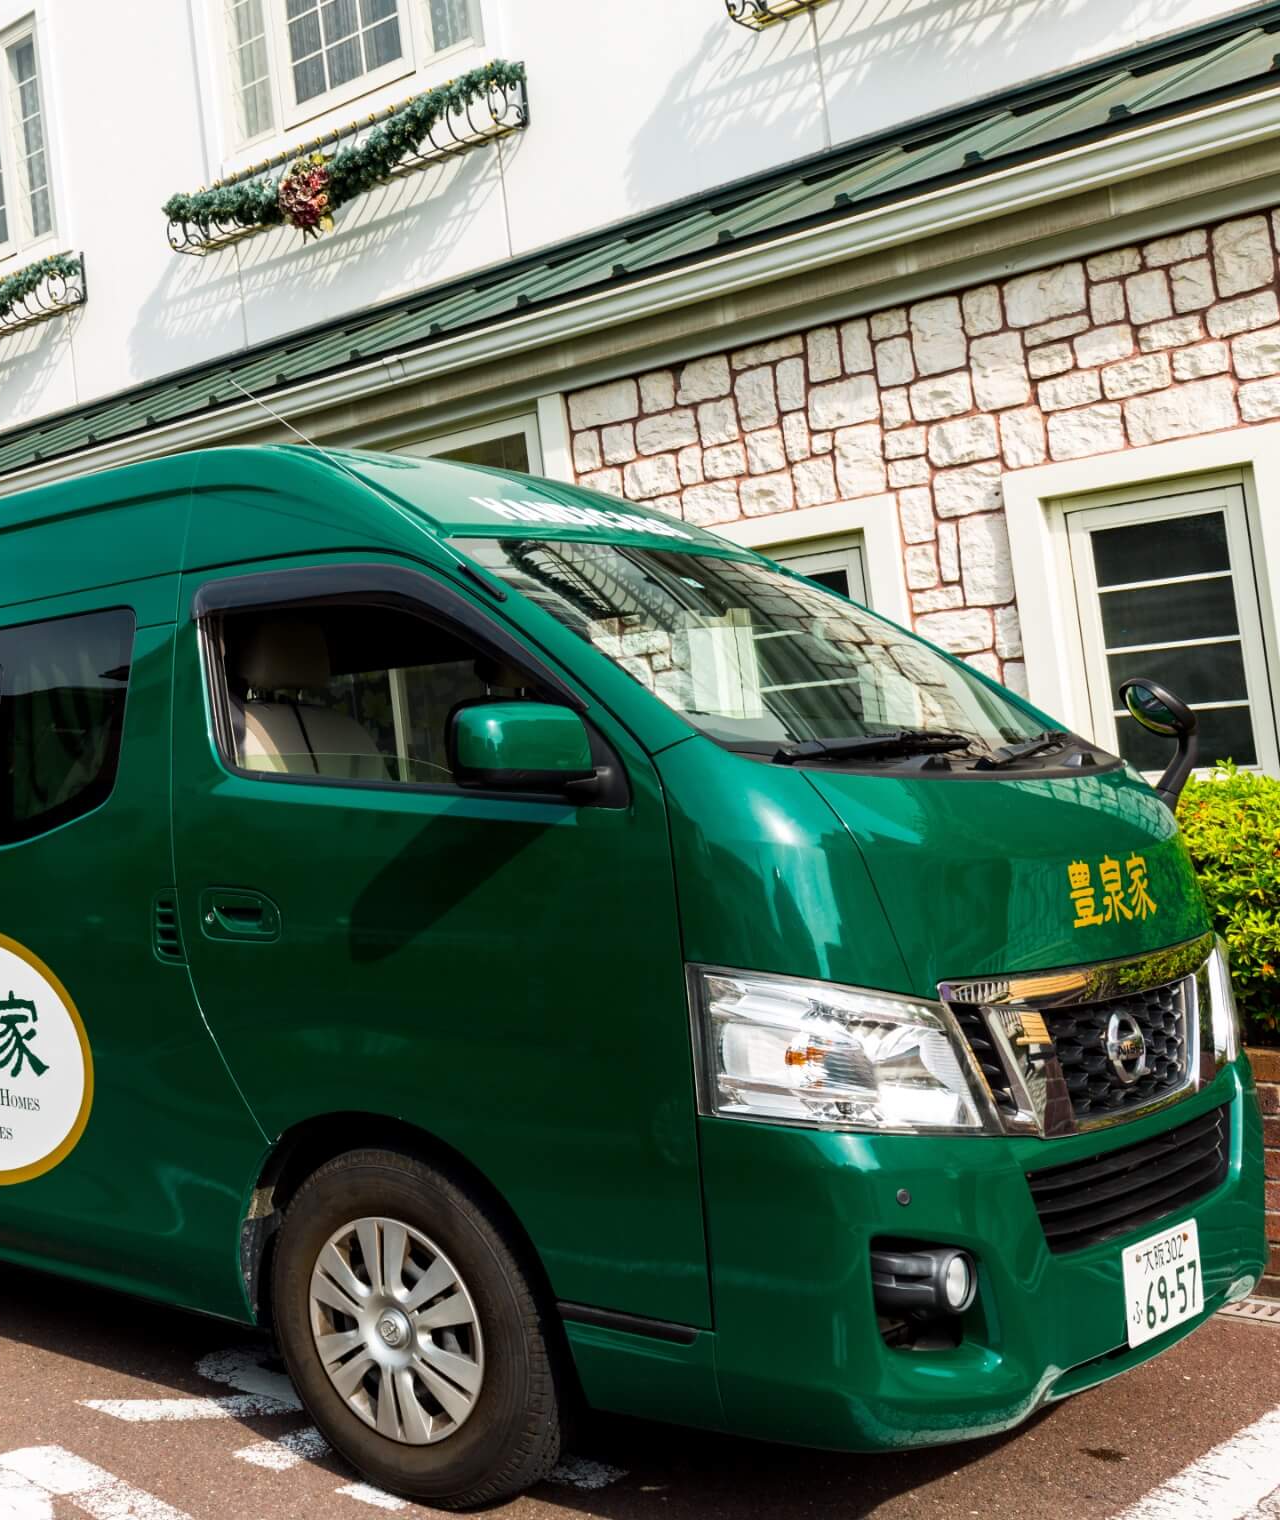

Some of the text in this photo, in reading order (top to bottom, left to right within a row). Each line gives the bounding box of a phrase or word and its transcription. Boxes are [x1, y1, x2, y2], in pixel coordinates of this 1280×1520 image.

[468, 495, 695, 541] HANDICABS
[1067, 851, 1157, 929] 豊泉家
[1142, 1234, 1184, 1275] 大阪302
[1133, 1259, 1197, 1330] ふ 69-57
